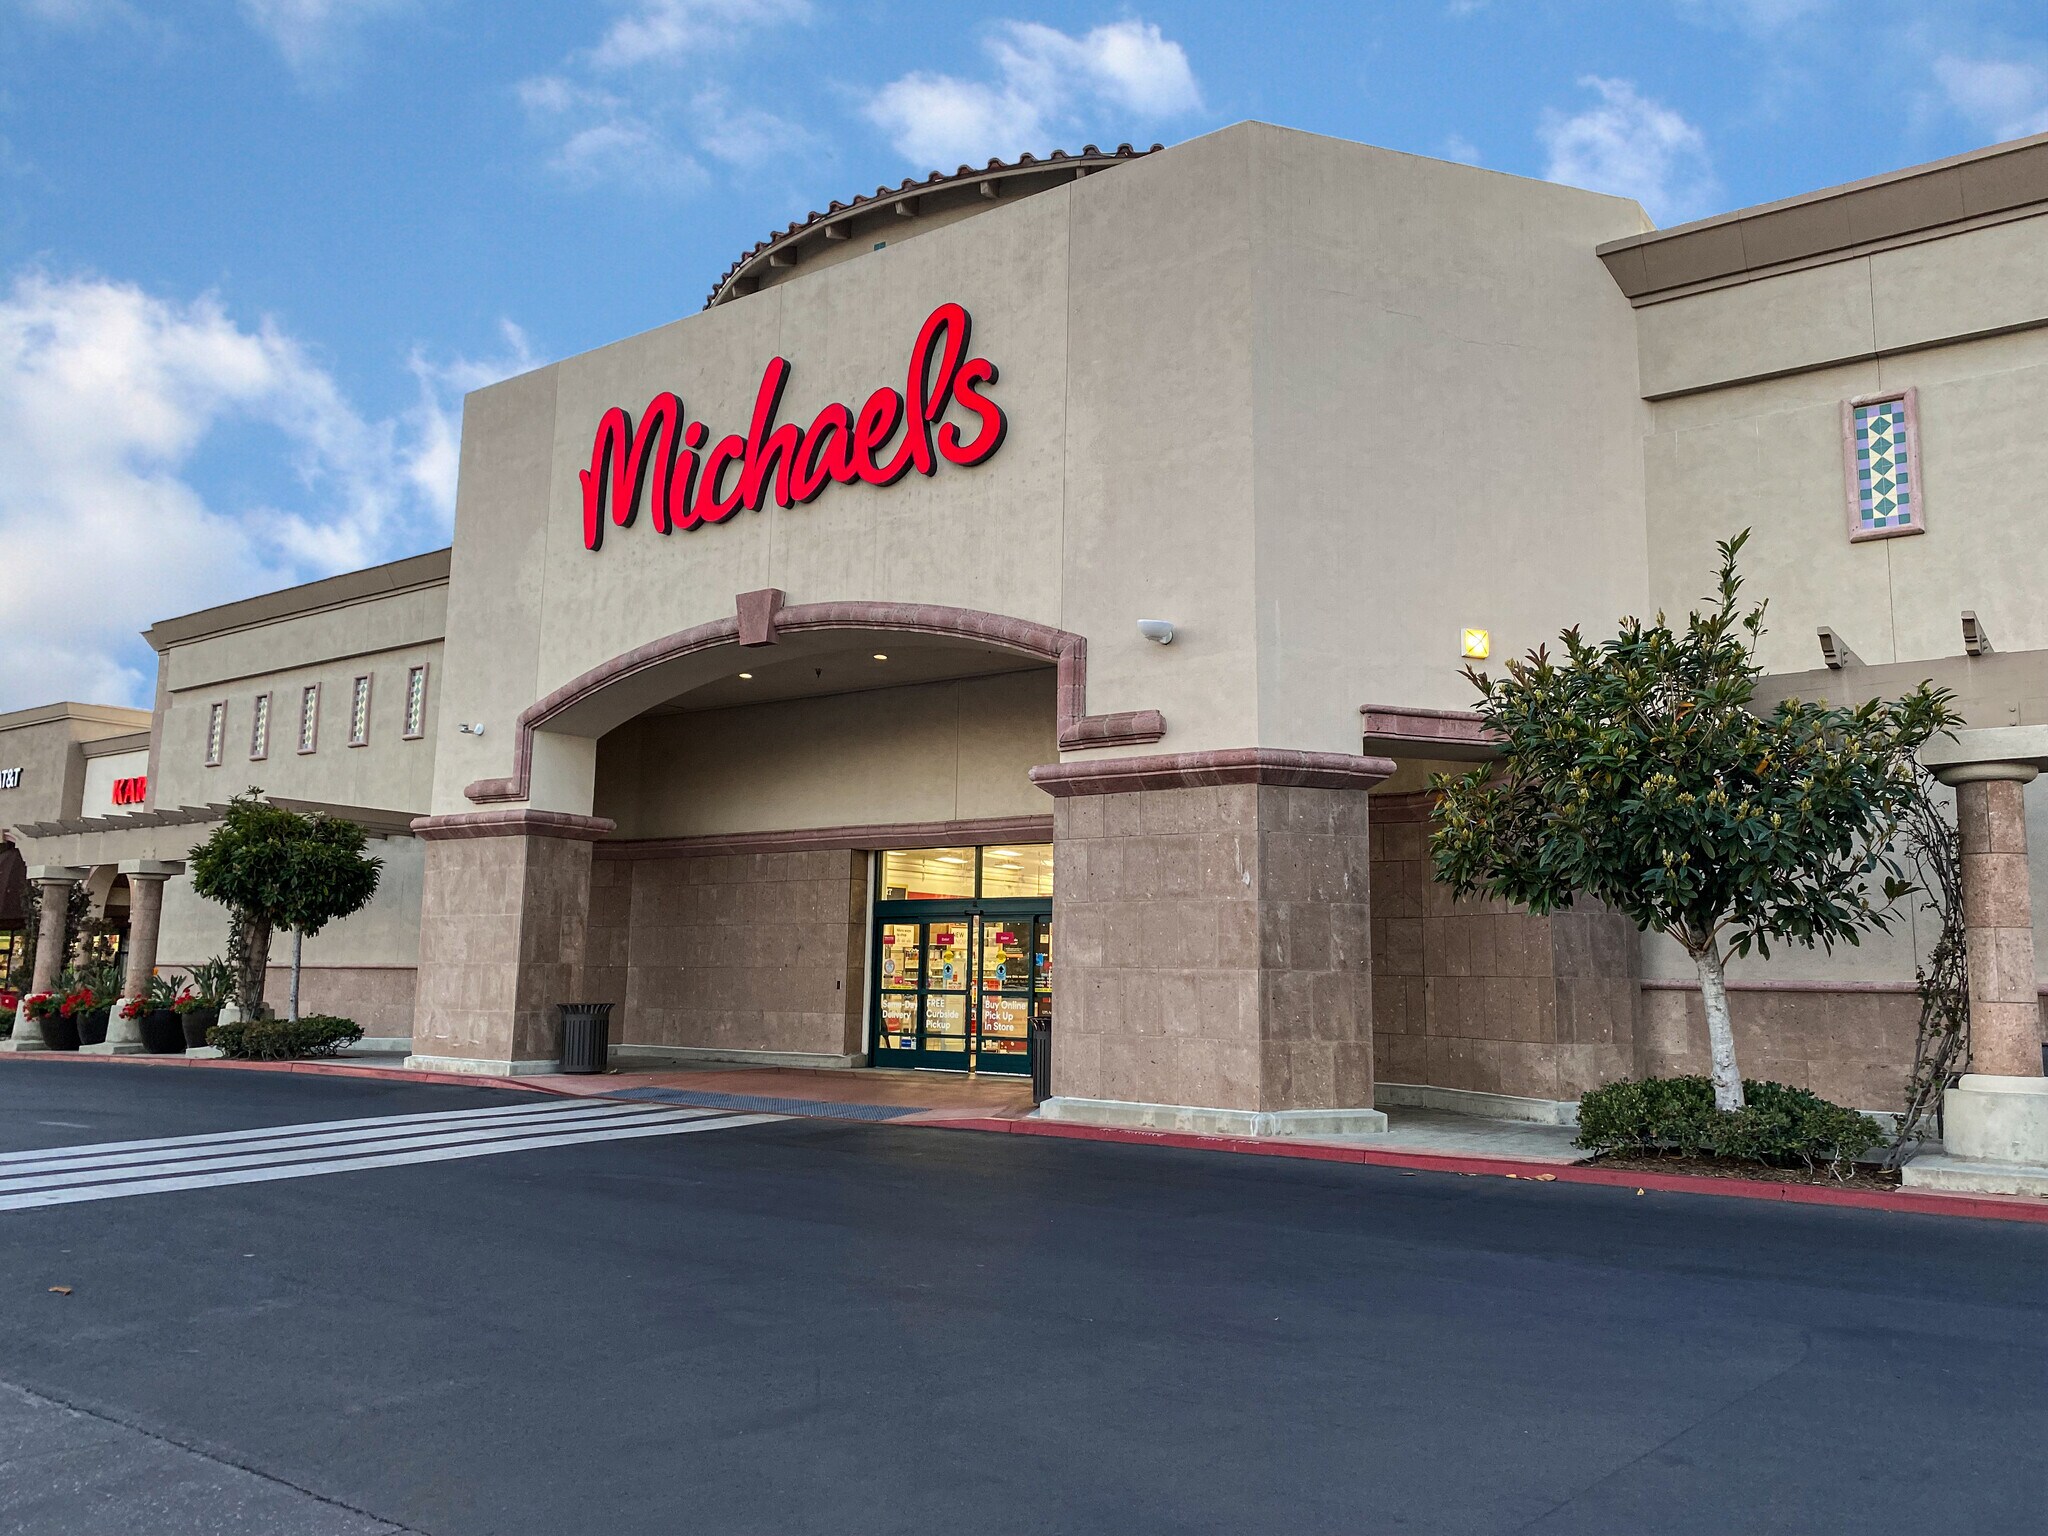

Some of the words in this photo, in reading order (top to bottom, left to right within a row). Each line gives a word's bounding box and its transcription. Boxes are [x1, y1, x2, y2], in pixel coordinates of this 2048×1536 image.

[579, 302, 1008, 552] Michaels
[0, 767, 21, 788] T&T
[926, 999, 945, 1008] FREE
[985, 1000, 1000, 1010] Buy
[1001, 1000, 1026, 1010] Online
[882, 1010, 912, 1020] Delivery
[926, 1009, 960, 1019] Curbside
[985, 1010, 1001, 1020] Pick
[1002, 1011, 1014, 1022] Up
[926, 1019, 951, 1031] Pickup
[984, 1021, 992, 1031] In
[993, 1022, 1015, 1032] Store
